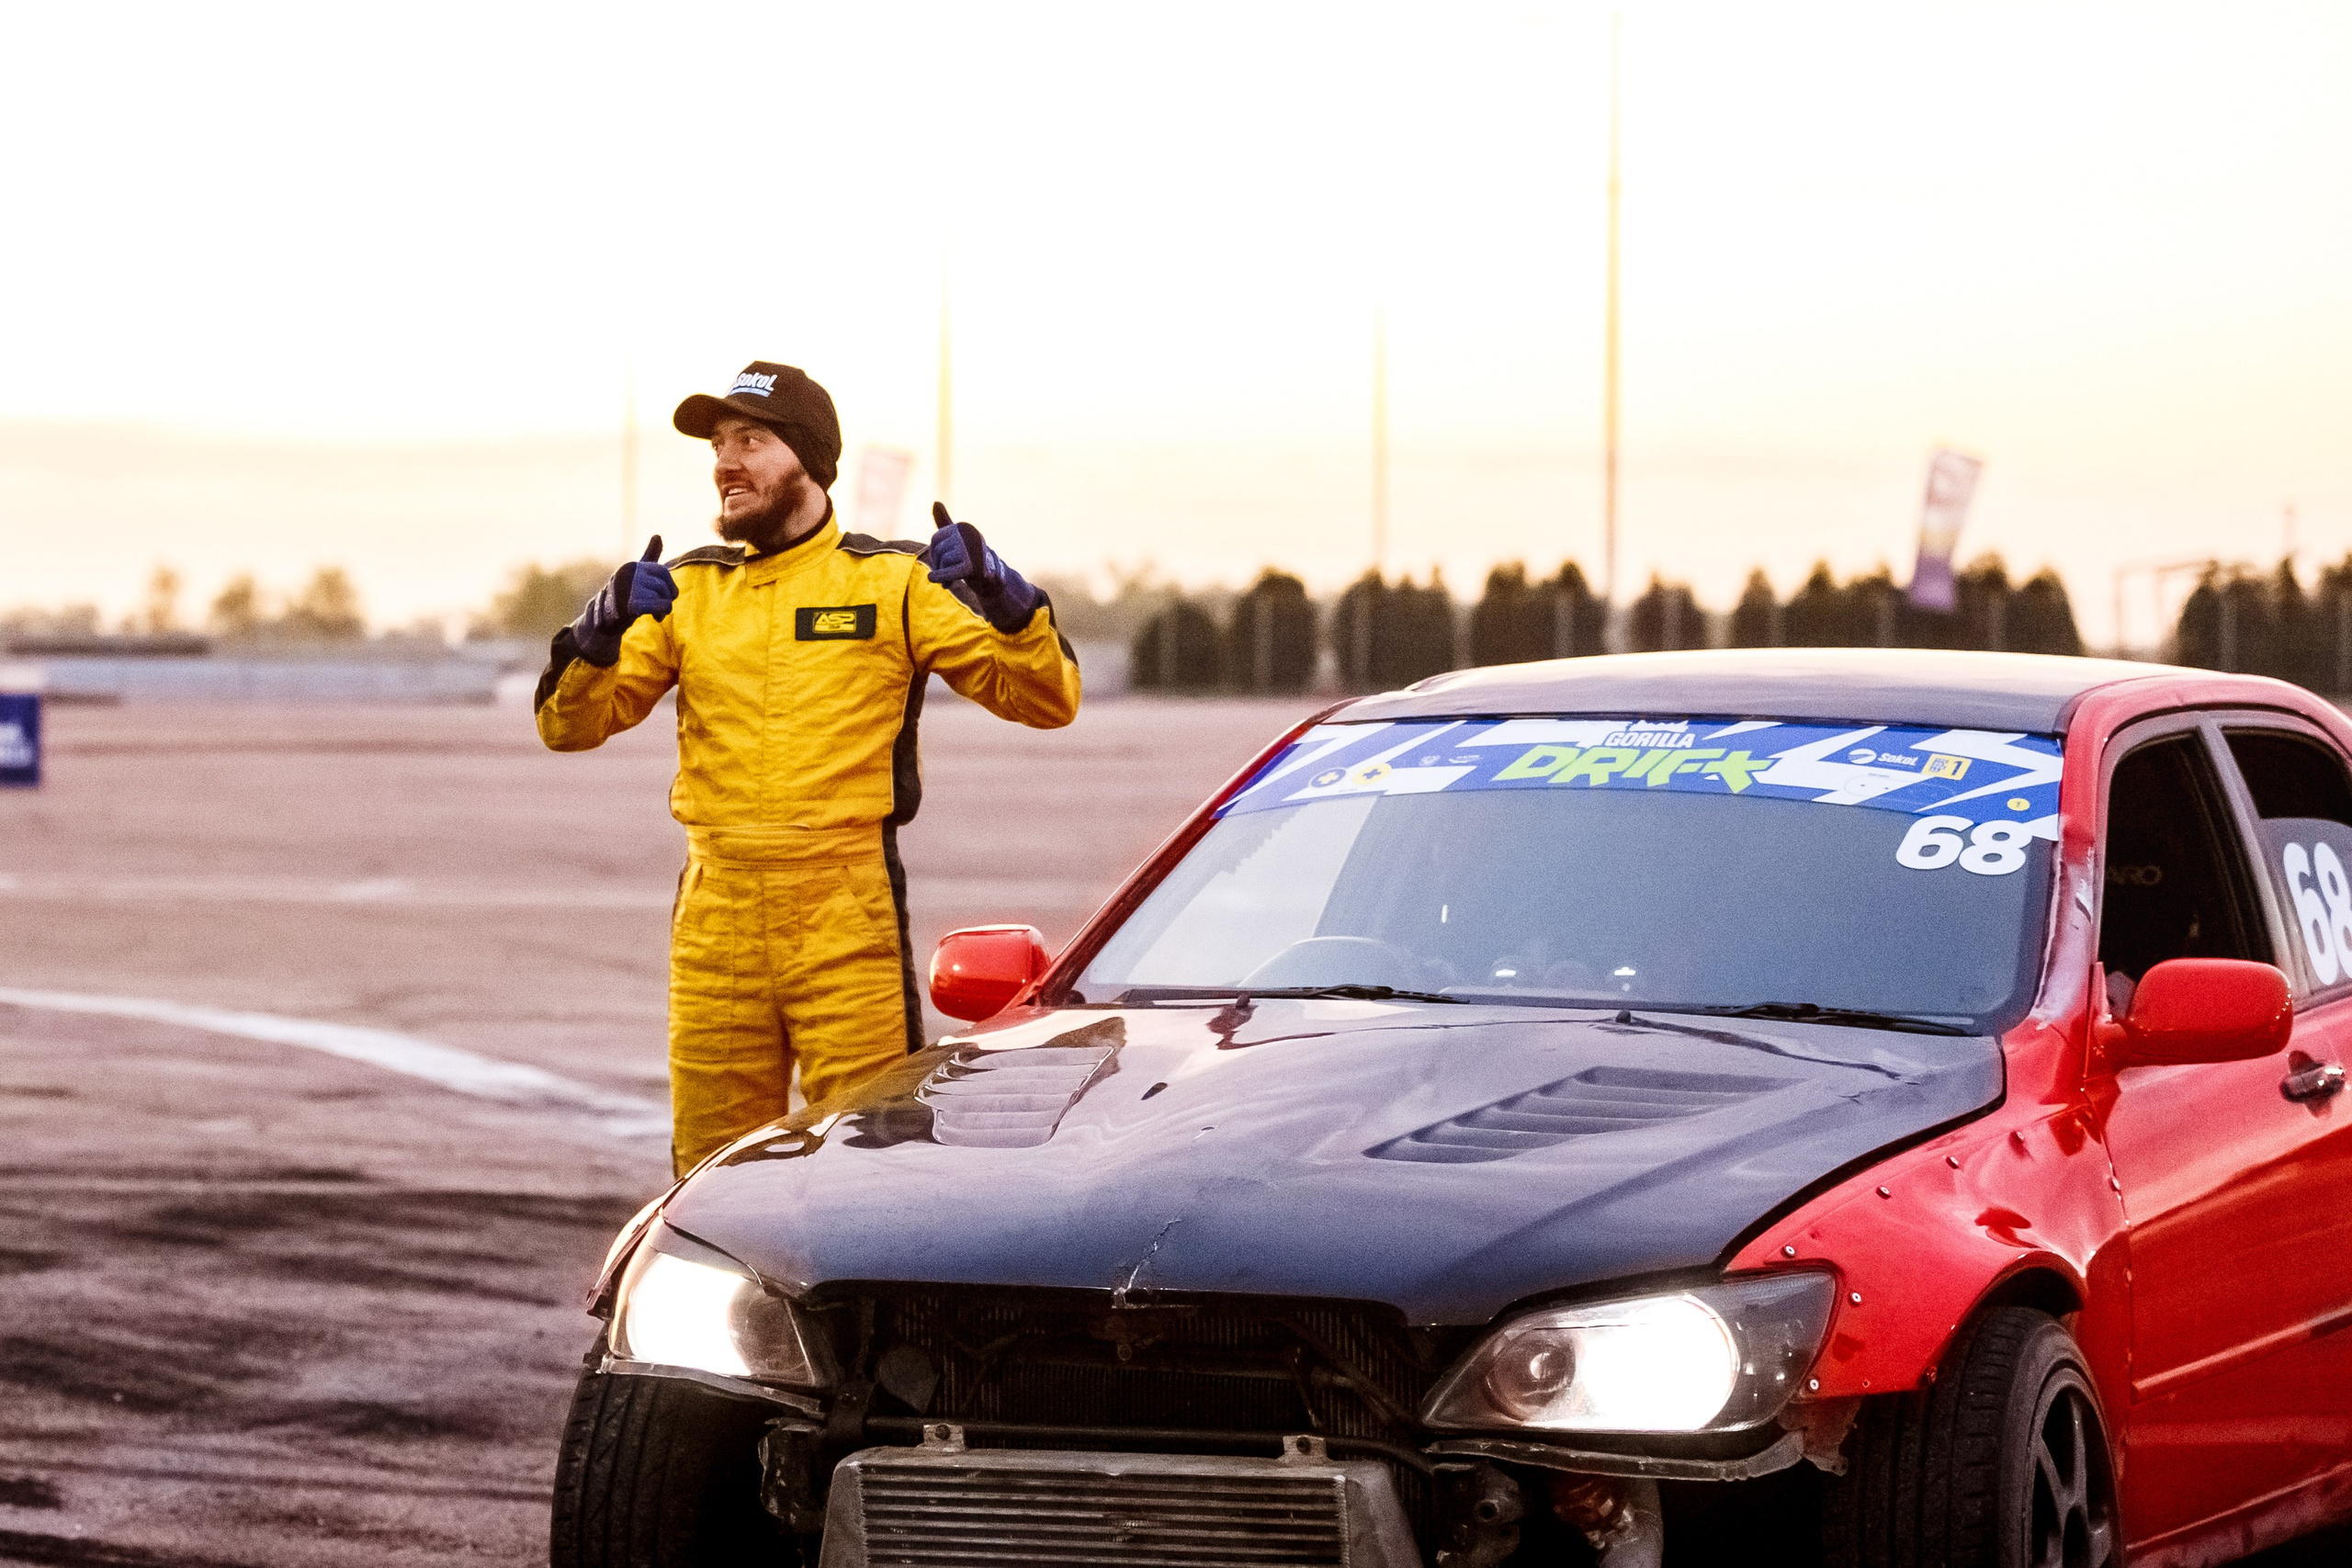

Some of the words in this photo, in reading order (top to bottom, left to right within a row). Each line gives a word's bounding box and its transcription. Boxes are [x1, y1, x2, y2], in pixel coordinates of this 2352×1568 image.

[1604, 732, 1695, 748] GORILLA
[1490, 745, 1773, 794] DRIFT
[1895, 815, 2033, 875] 68
[2283, 842, 2352, 986] 68
